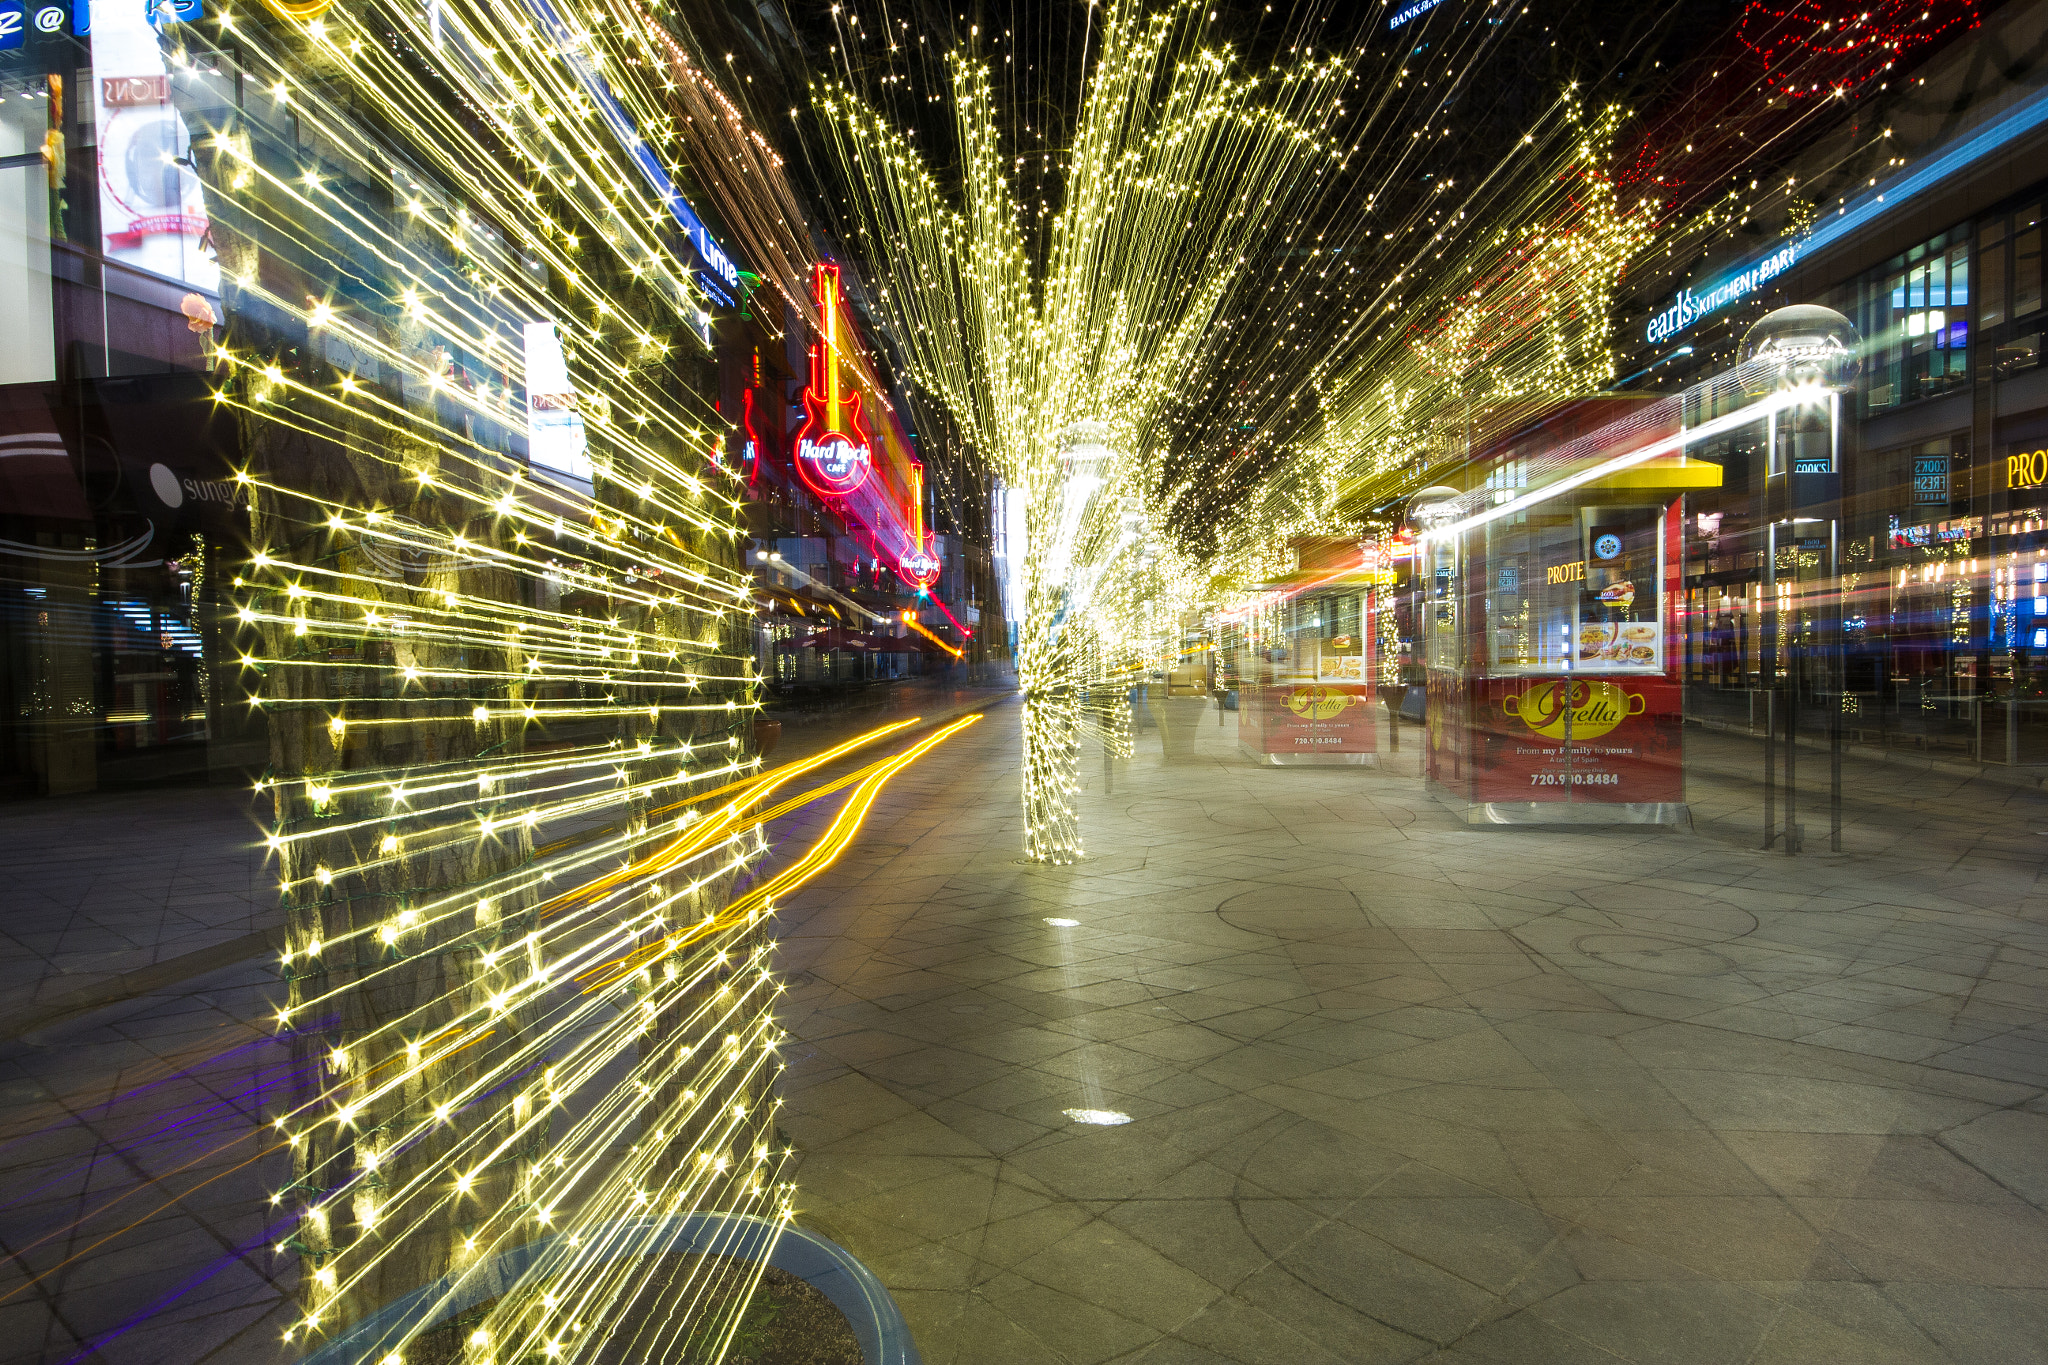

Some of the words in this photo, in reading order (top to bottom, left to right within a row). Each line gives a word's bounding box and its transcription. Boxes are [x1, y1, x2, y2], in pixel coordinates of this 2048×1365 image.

[34, 6, 65, 33] @
[1390, 5, 1420, 30] BANK
[700, 226, 738, 288] Lime
[1699, 271, 1751, 315] KITCHEN
[800, 438, 836, 460] Hard
[835, 440, 869, 466] Rock
[826, 463, 847, 473] CAFE
[1796, 462, 1827, 473] COOK'S
[902, 557, 918, 569] Hard
[1516, 747, 1540, 755] From
[1542, 748, 1556, 756] my
[1559, 746, 1592, 756] Fmily
[1594, 747, 1604, 755] to
[1605, 748, 1633, 756] yours
[1581, 756, 1600, 765] Spain
[1530, 773, 1620, 786] 720.90.8484
